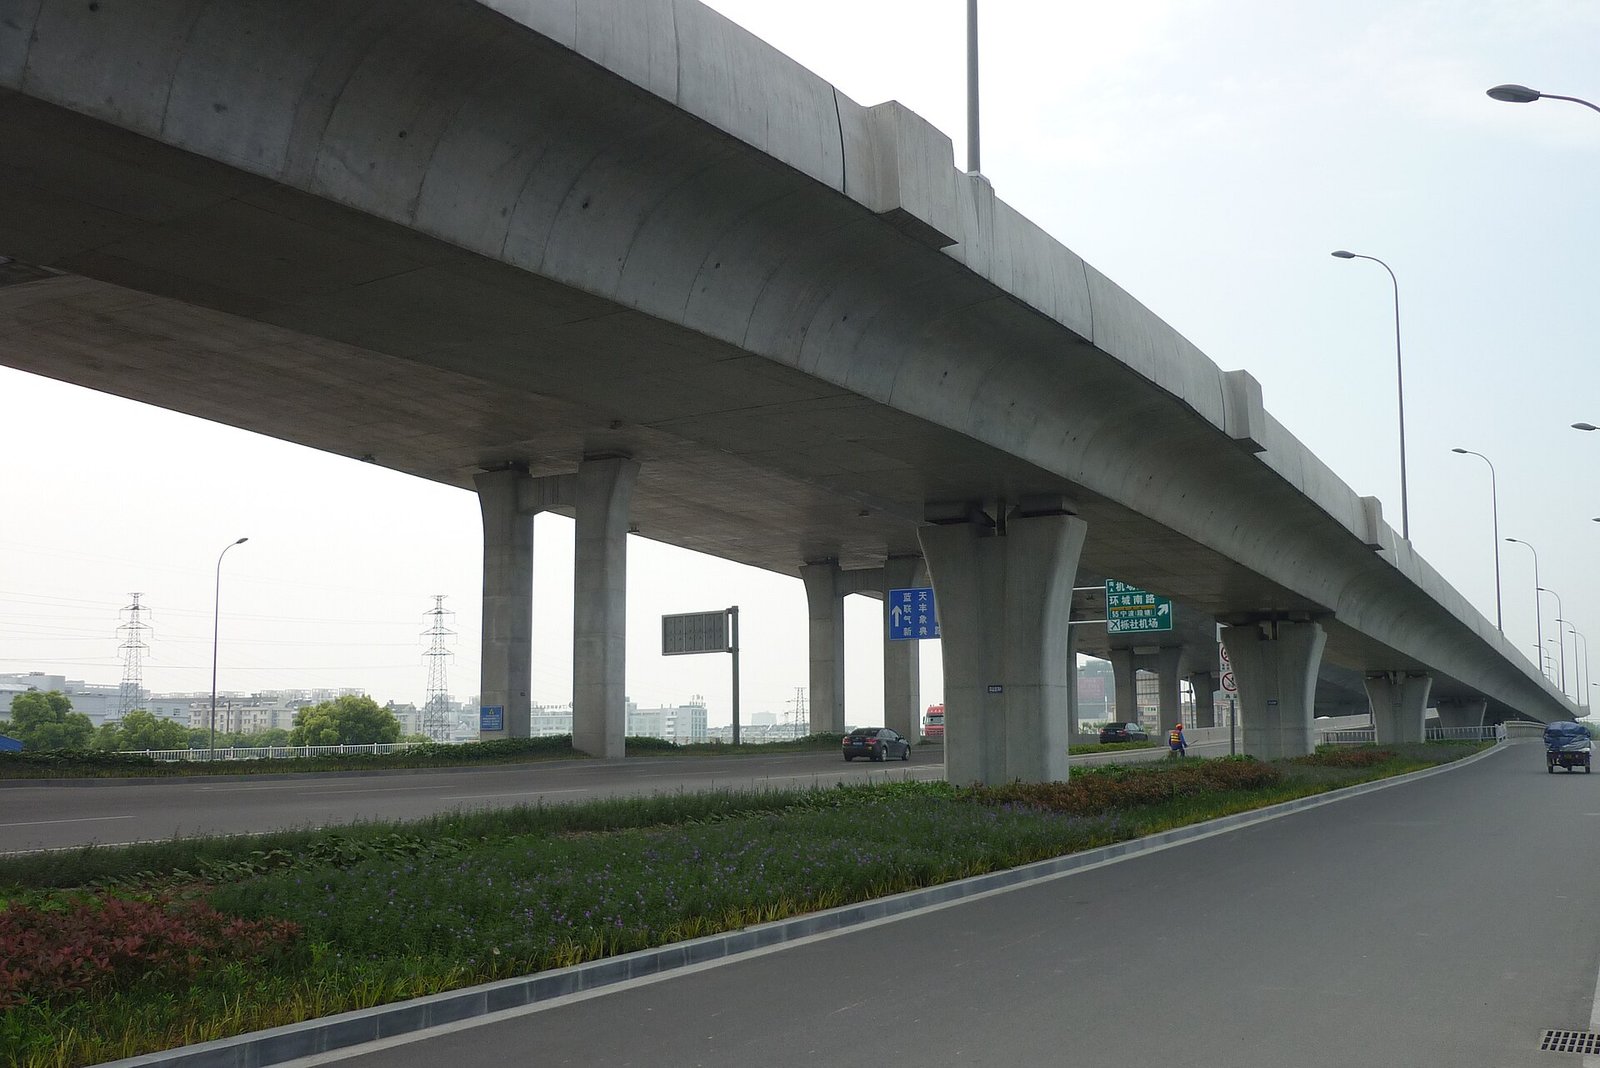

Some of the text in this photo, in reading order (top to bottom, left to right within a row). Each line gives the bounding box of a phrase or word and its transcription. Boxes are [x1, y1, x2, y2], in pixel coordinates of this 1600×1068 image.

[1109, 594, 1155, 606] 环城南路
[1120, 618, 1158, 630] 栎社机场
